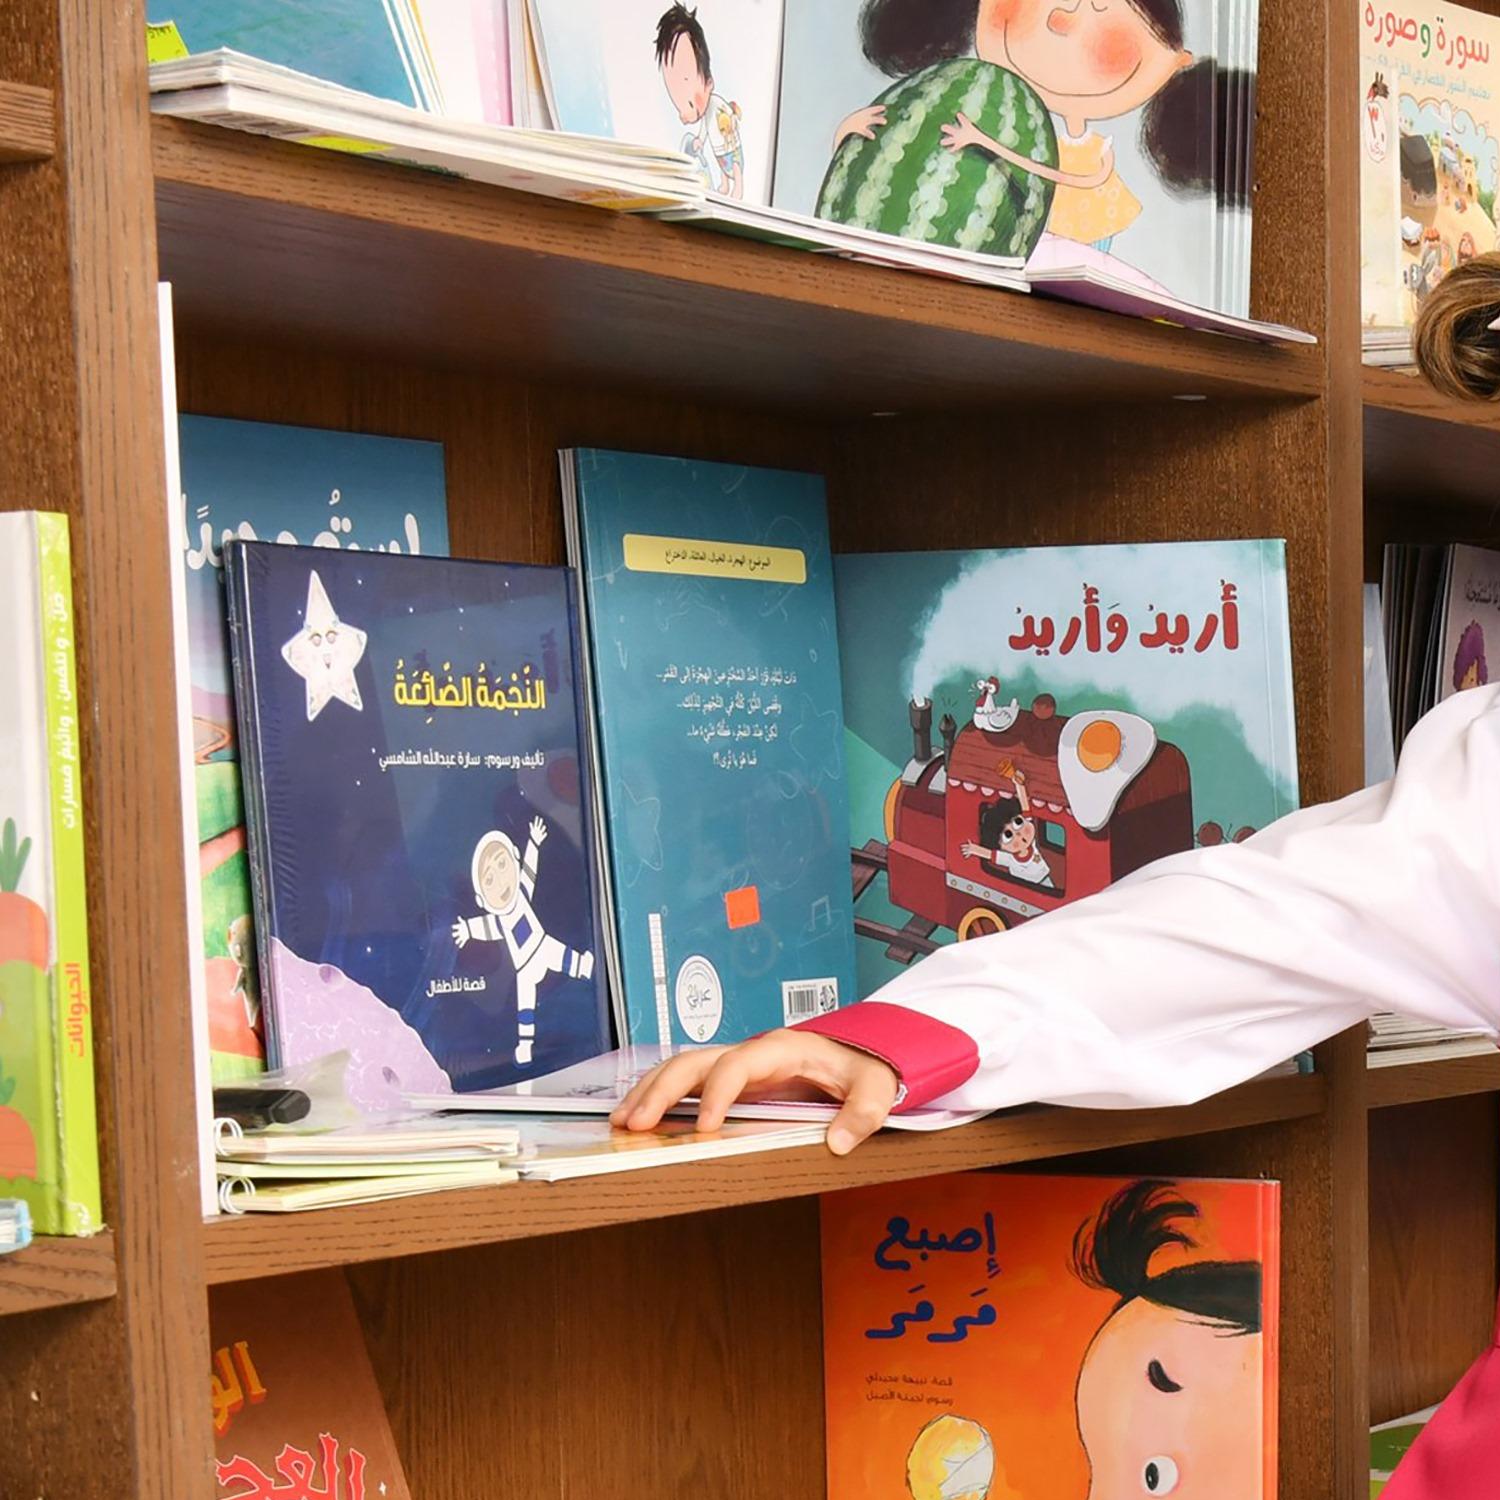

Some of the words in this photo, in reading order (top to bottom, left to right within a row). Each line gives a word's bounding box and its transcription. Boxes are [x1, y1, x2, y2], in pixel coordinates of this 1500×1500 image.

[1437, 16, 1490, 69] سورة
[379, 749, 421, 773] الشامسي
[423, 747, 457, 766] عبدالله
[459, 750, 481, 768] سارة
[520, 750, 545, 768] تأليف
[426, 974, 463, 998] للأطفال
[463, 975, 487, 991] قصة
[63, 962, 89, 1058] الحيوانات
